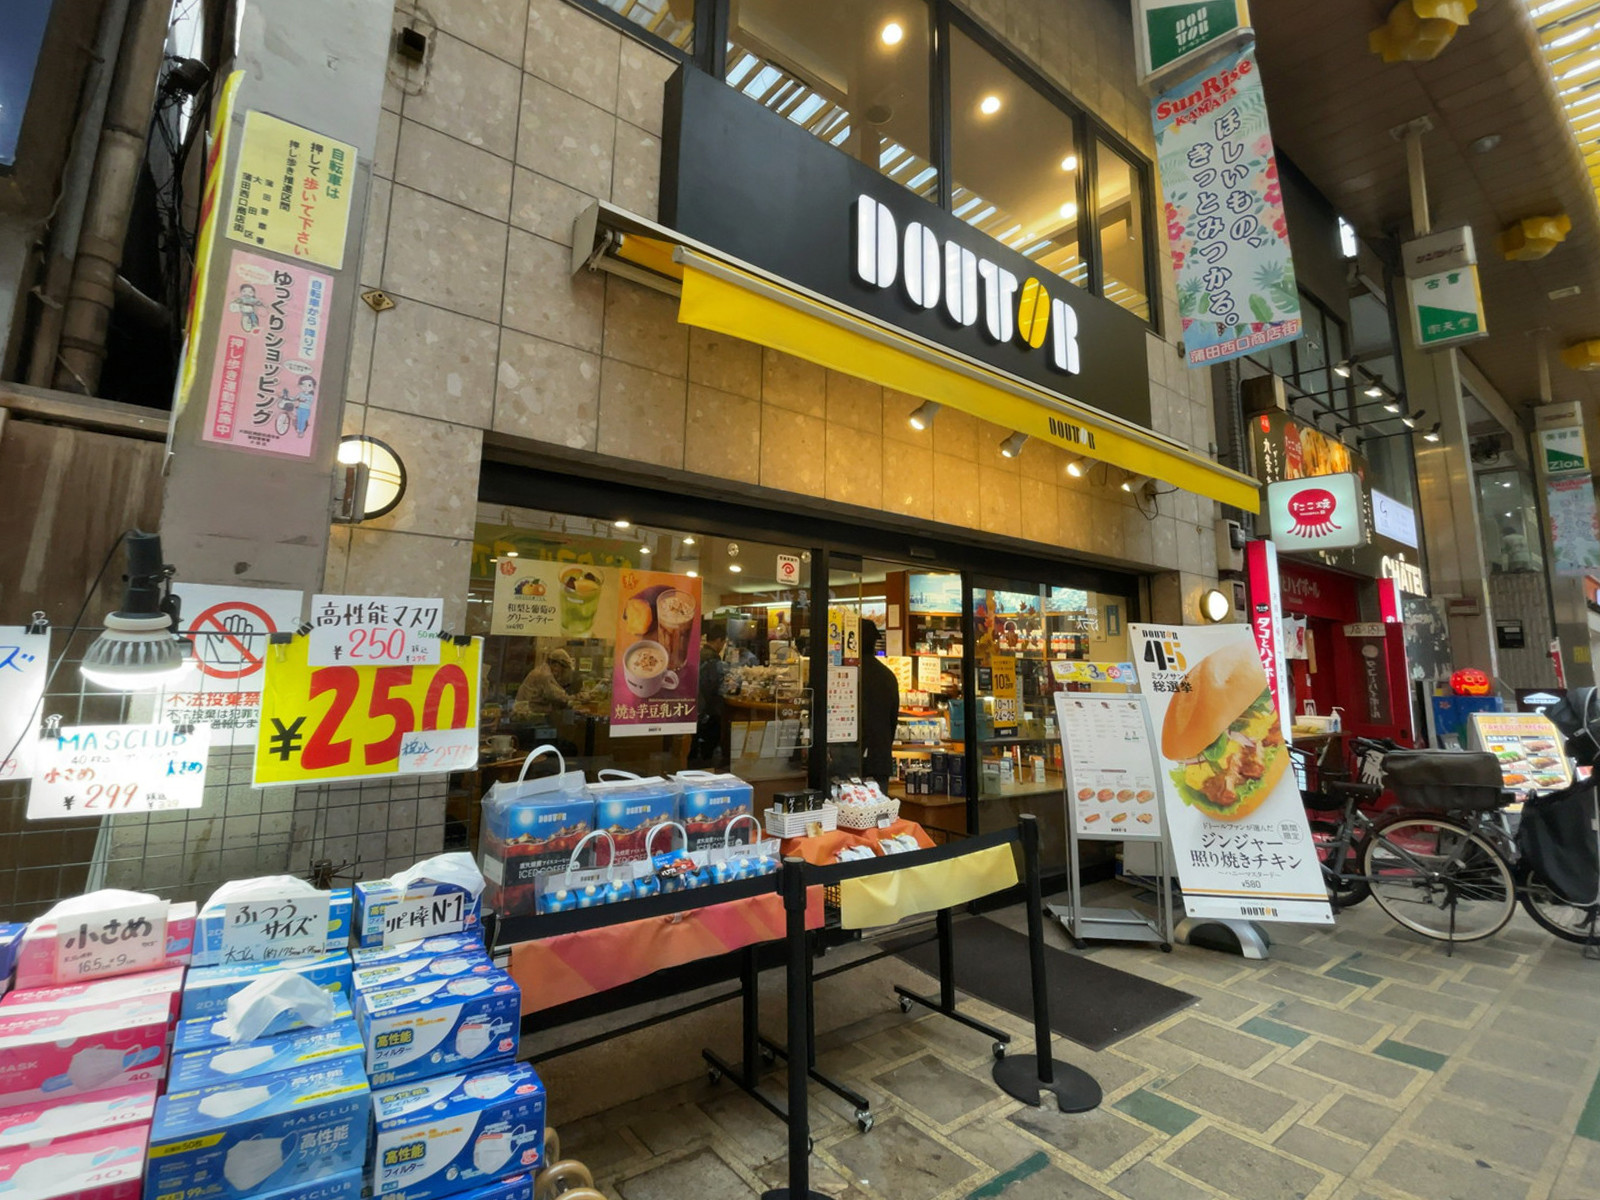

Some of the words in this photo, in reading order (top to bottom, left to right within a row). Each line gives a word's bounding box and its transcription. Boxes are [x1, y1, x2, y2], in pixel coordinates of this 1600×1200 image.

[1156, 59, 1253, 120] SunRise
[1175, 87, 1237, 126] KAMATA
[326, 147, 345, 200] 自転車は
[857, 193, 1080, 375] DOUTOR
[252, 269, 293, 426] ゆっくりショッピング
[1190, 319, 1297, 363] 蒲田西口商店街
[1048, 416, 1096, 450] DOUTOR
[316, 601, 439, 630] 高性能マスク
[1144, 640, 1187, 672] 45
[614, 702, 696, 720] 焼き芋豆乳オレ
[1201, 832, 1284, 851] ジンジャー
[1190, 849, 1303, 871] 照り焼きチキン
[234, 899, 298, 924] ふつう
[1240, 906, 1279, 917] DOUTOR
[65, 916, 152, 950] 小さめ
[260, 914, 318, 940] サイズ
[376, 1029, 413, 1048] 高性能
[283, 1103, 360, 1129] MASCLUB
[300, 1123, 350, 1151] 高性能
[299, 1141, 349, 1161] フィルター
[384, 1143, 425, 1165] 高性能
[384, 1164, 425, 1178] フィルター
